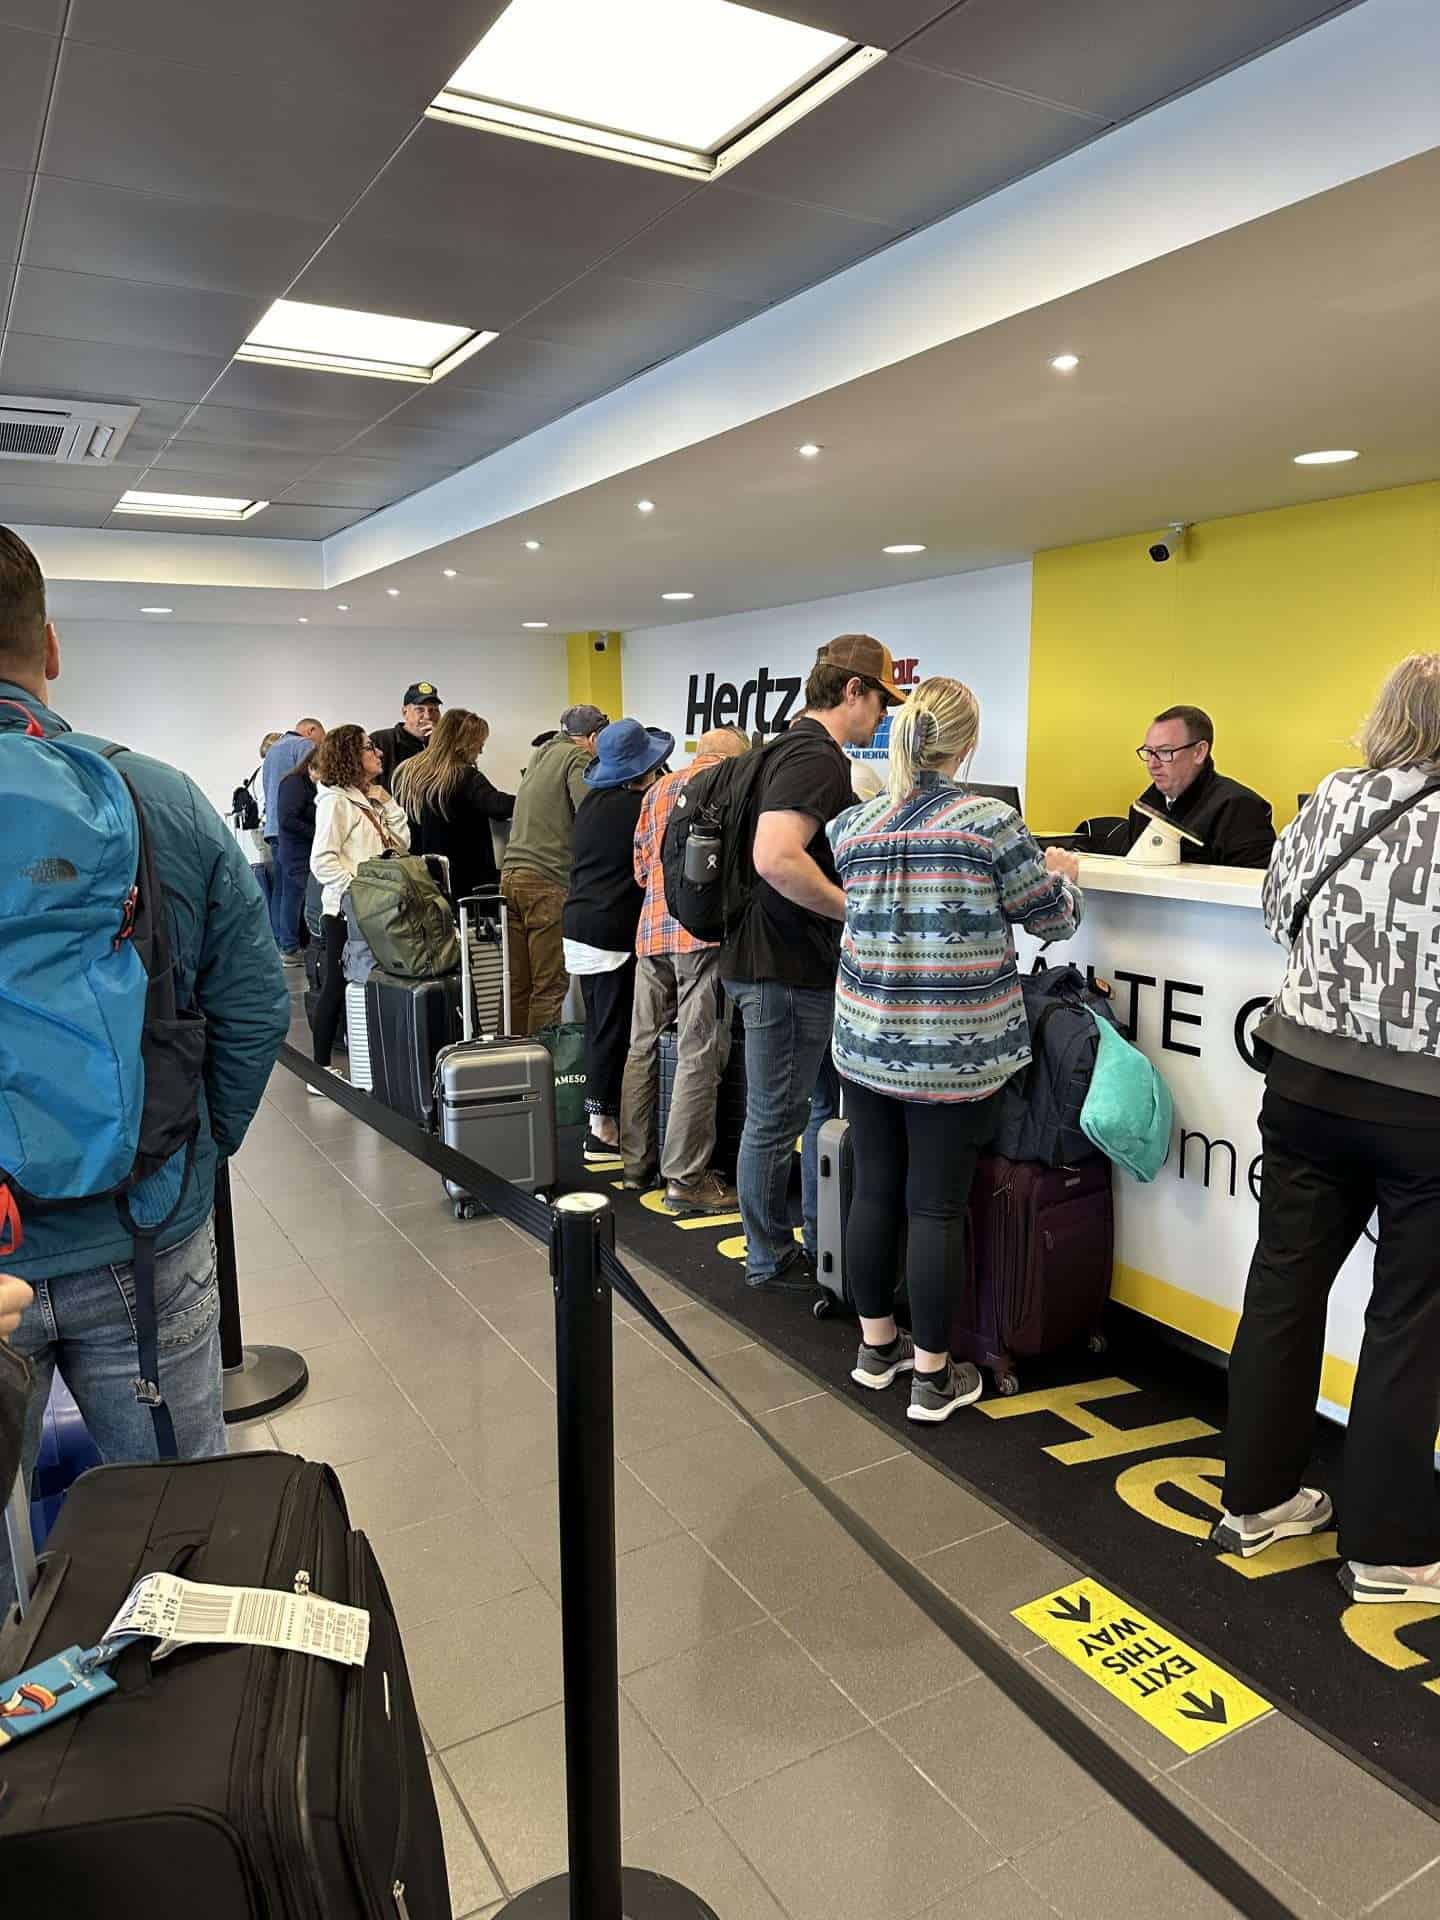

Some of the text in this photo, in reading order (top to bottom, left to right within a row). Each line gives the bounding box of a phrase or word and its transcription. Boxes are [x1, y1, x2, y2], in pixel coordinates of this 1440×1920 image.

[686, 667, 802, 735] Hertz
[554, 1074, 587, 1088] AMESO
[1077, 1616, 1148, 1658] WAY
[1101, 1636, 1172, 1676] THIS
[1130, 1654, 1198, 1698] EXIT
